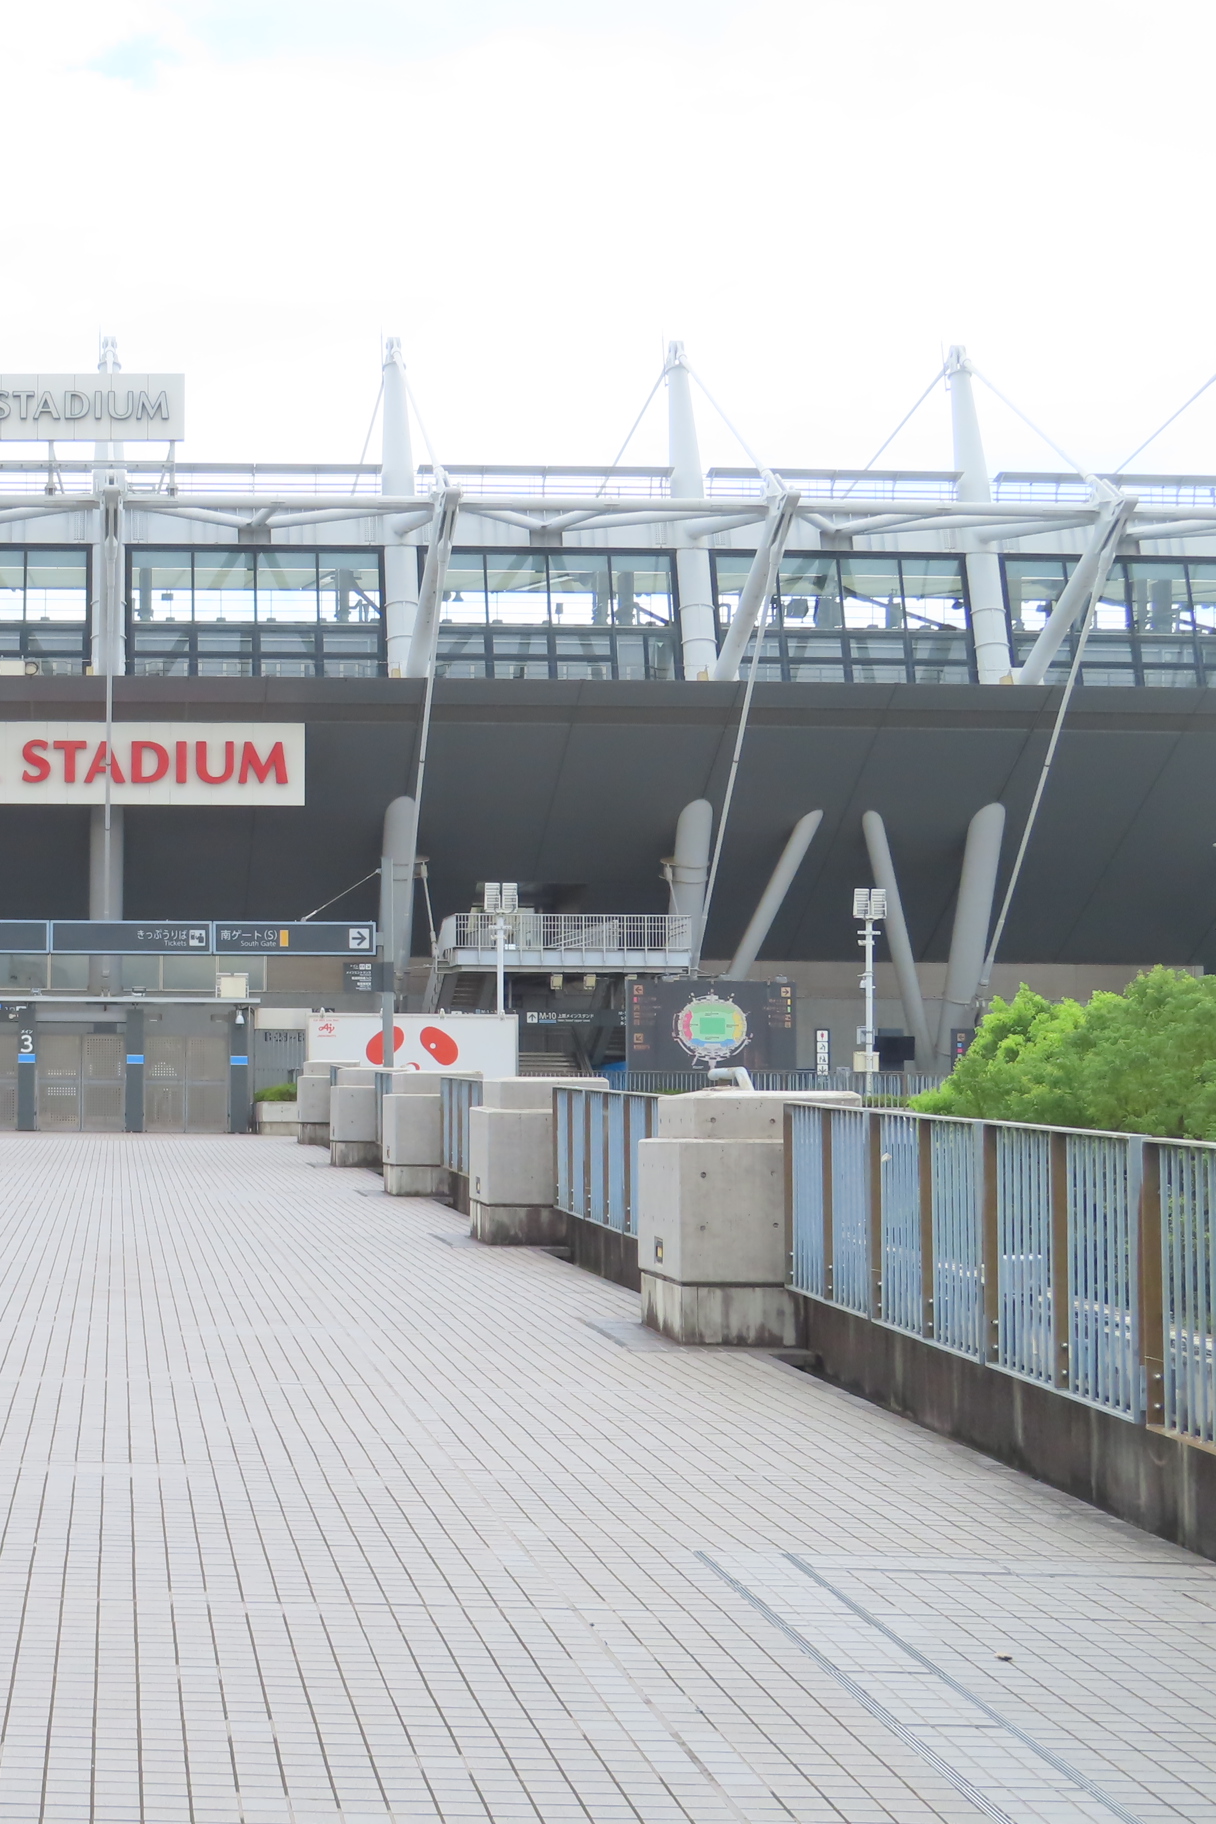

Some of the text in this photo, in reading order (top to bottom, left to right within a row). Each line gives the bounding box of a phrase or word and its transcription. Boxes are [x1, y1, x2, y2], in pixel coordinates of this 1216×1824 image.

[22, 739, 289, 784] STADIUM
[137, 929, 187, 940] きっぷうりば
[220, 929, 277, 941] 南ゲート(S)
[539, 1012, 557, 1020] M-10
[20, 1034, 34, 1053] 3
